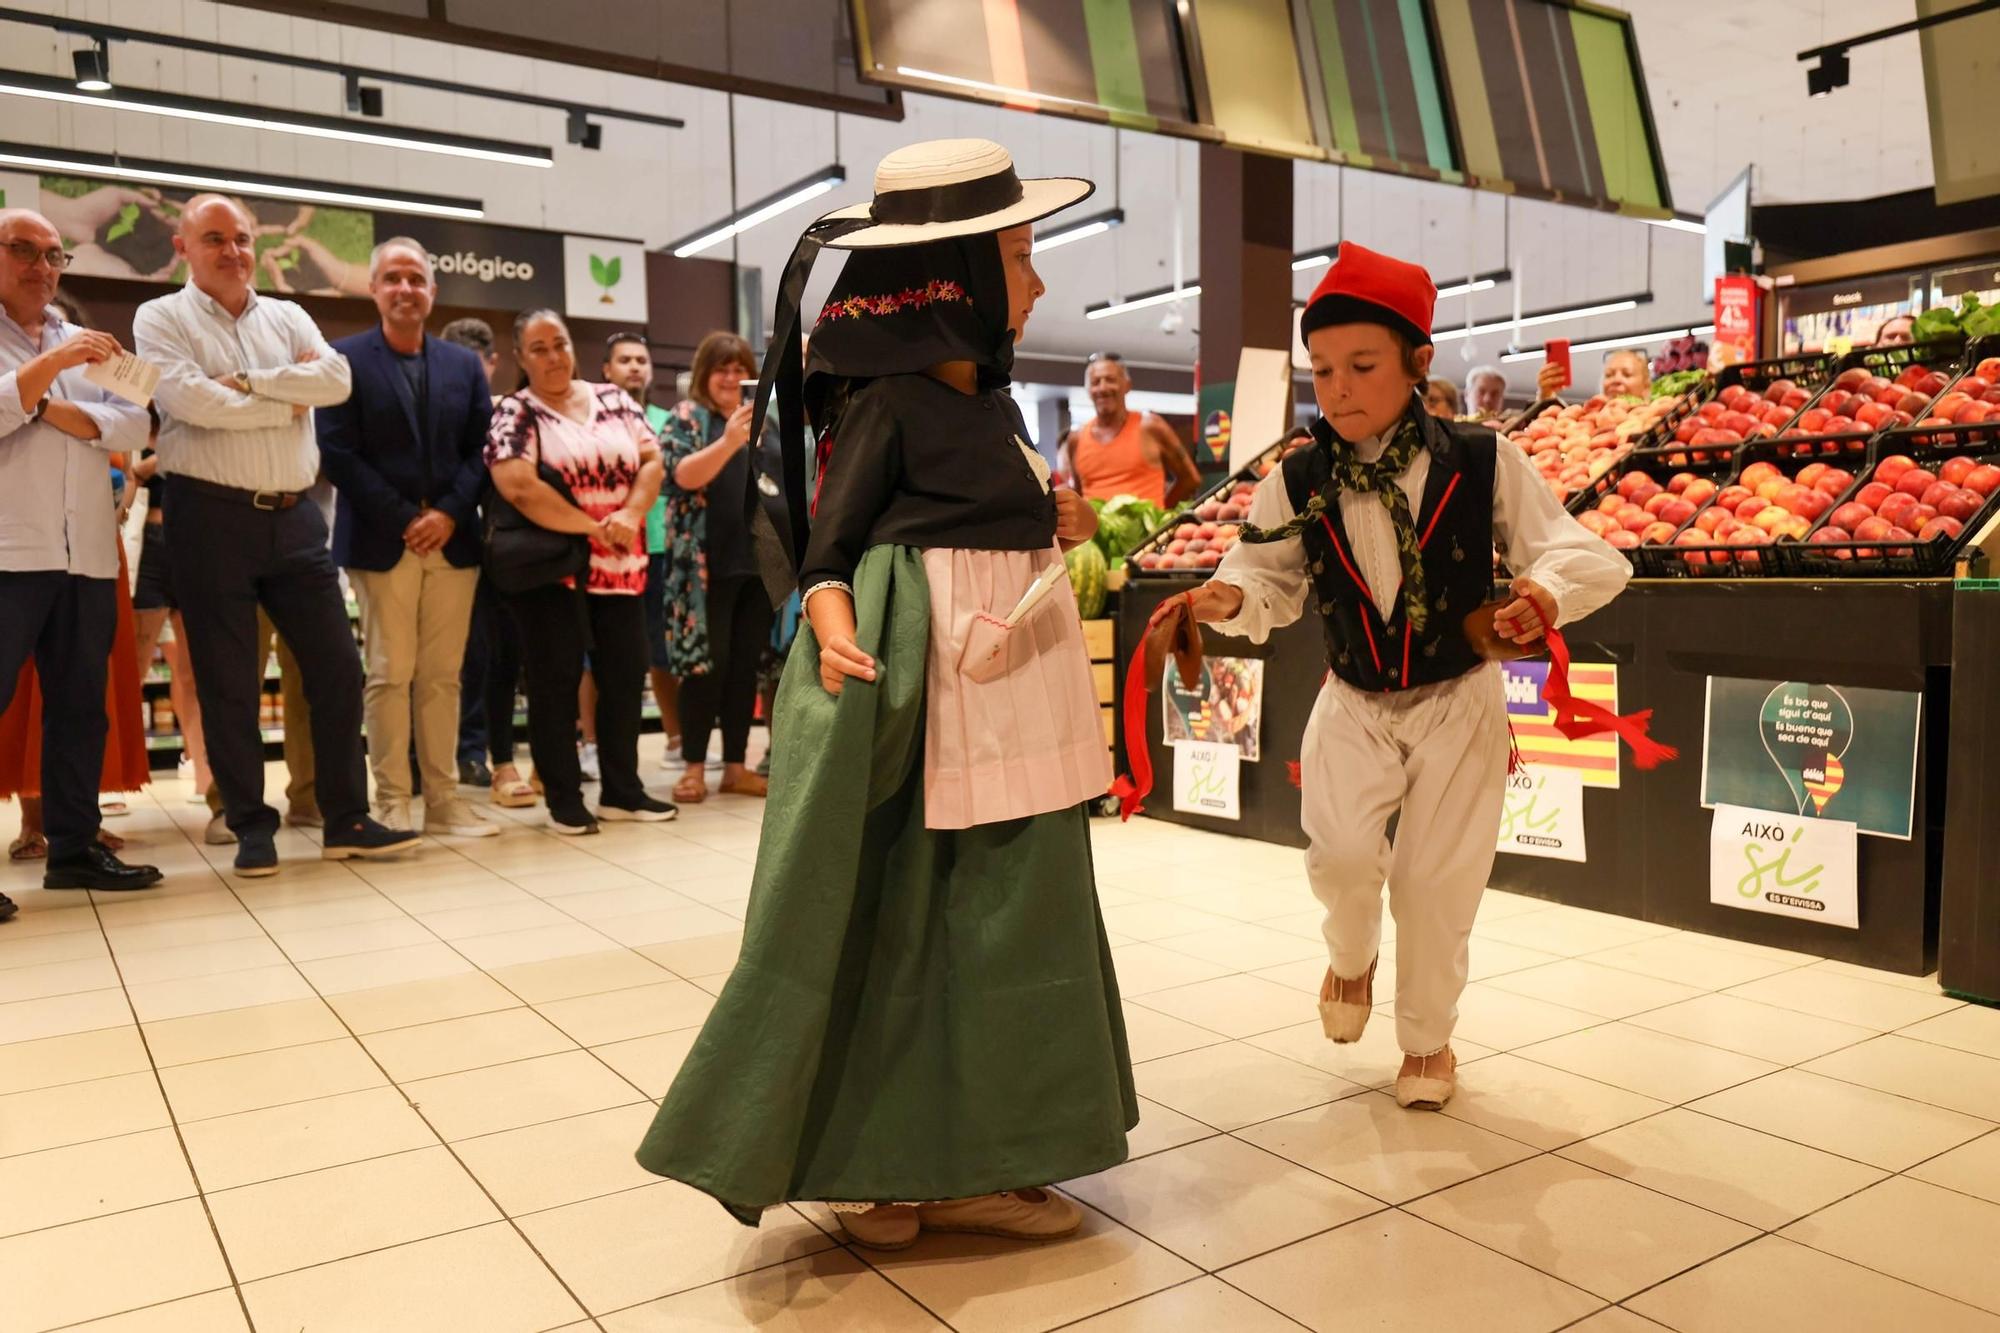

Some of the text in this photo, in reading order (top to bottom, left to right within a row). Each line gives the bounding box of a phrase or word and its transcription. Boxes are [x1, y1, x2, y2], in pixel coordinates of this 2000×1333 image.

[427, 252, 534, 282] cológico
[1795, 697, 1809, 707] bo
[1811, 699, 1828, 709] que
[1785, 722, 1816, 734] bueno
[1816, 727, 1833, 737] que
[1778, 733, 1795, 742] sea
[1796, 734, 1810, 744] de
